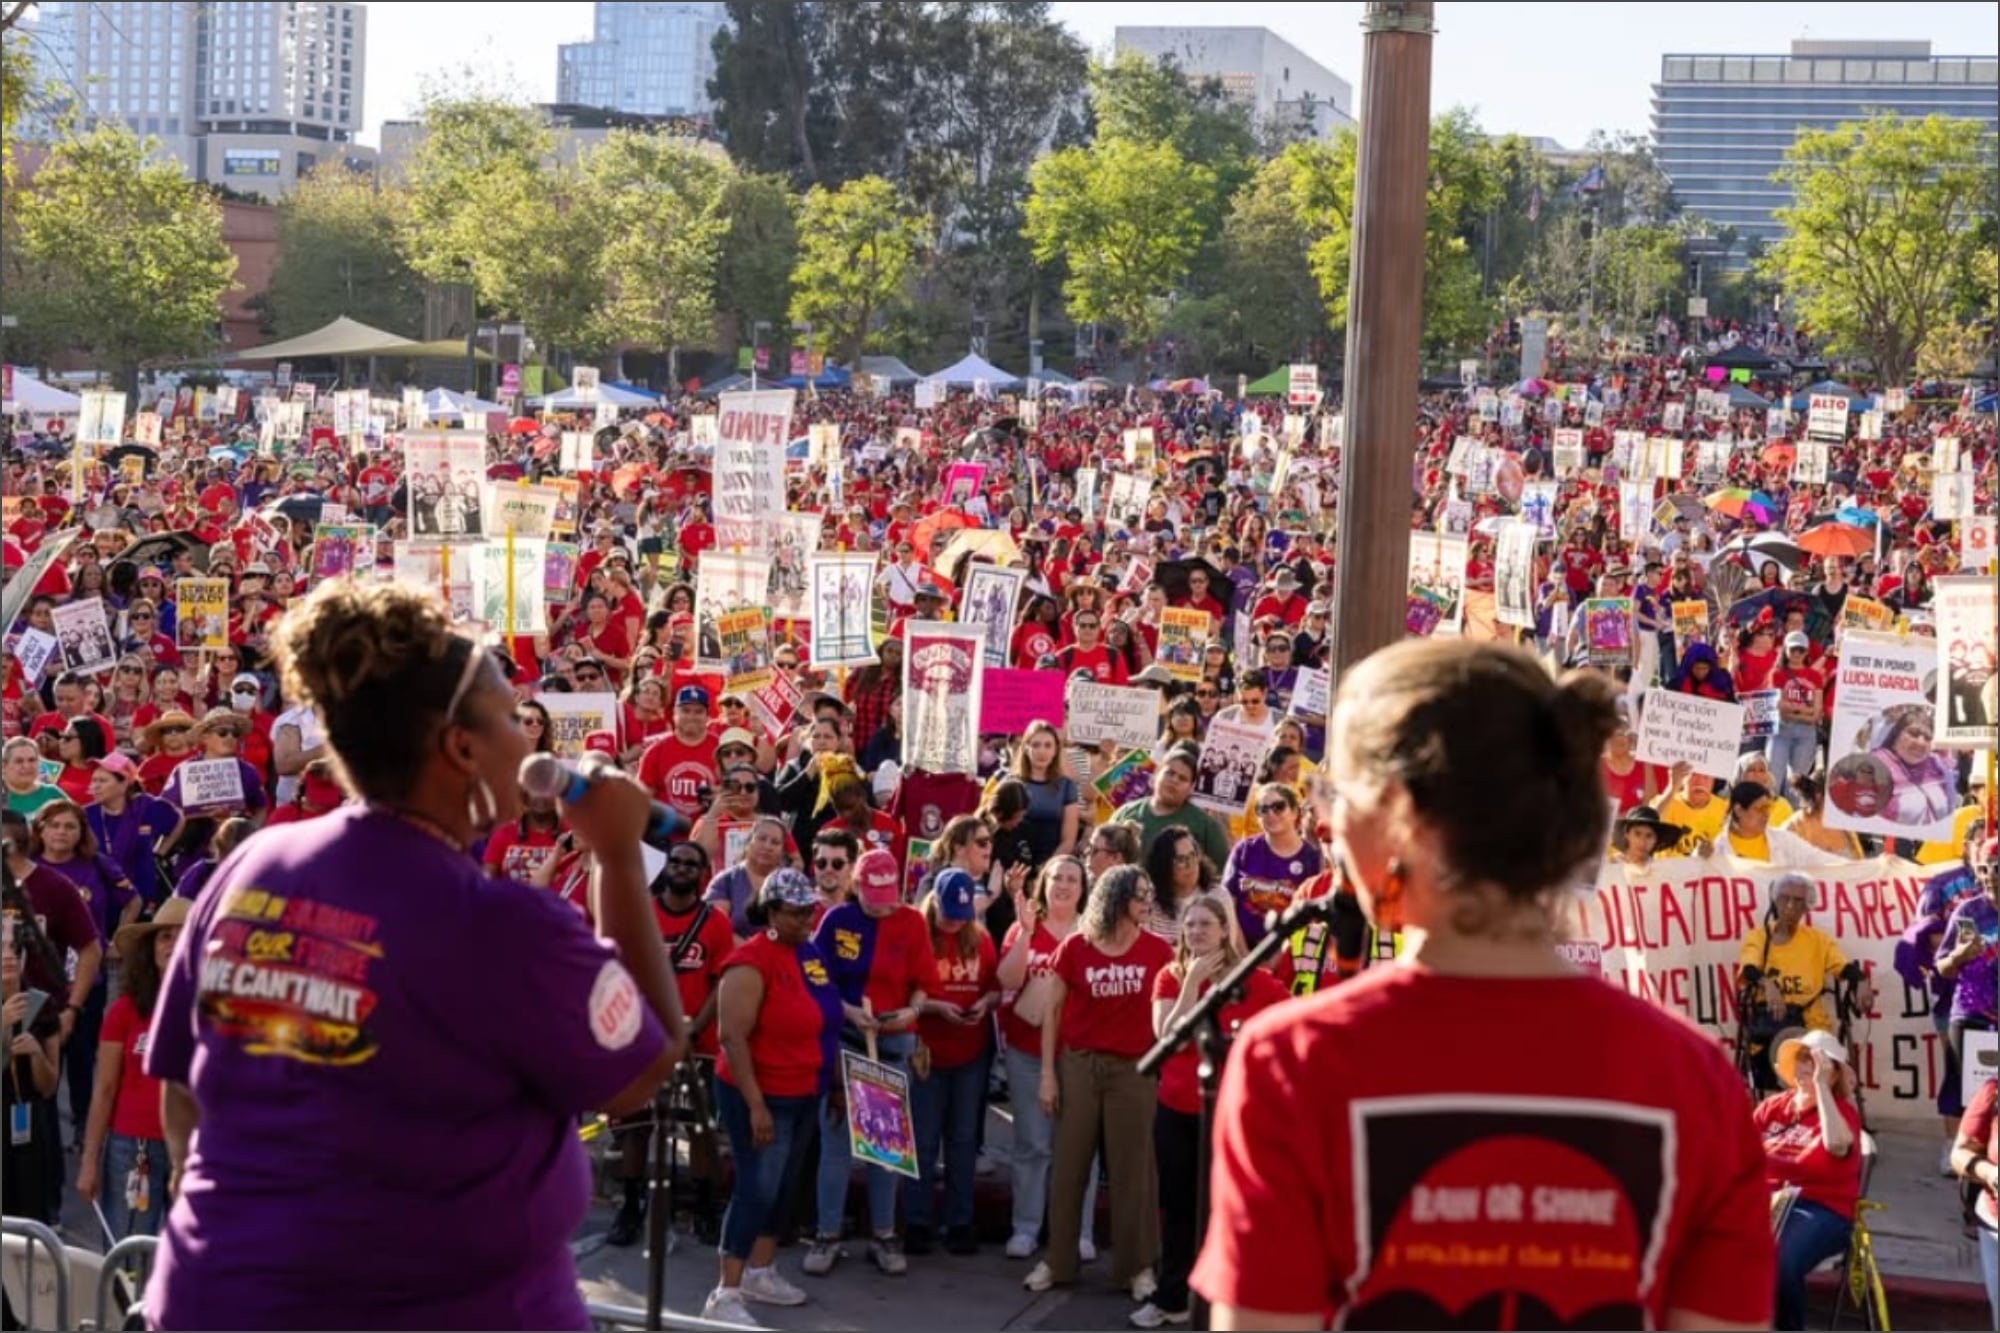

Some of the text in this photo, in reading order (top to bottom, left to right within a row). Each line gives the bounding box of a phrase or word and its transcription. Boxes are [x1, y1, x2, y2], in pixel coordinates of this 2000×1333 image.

[1812, 398, 1846, 410] ALTO
[504, 501, 547, 514] JUNTOS
[1850, 656, 1917, 672] REST IN POWER
[1843, 670, 1920, 692] LUCIA GARCIA
[551, 716, 603, 730] STRIKE
[1647, 710, 1662, 723] de
[1644, 727, 1671, 740] para
[1648, 740, 1708, 764] Especial
[1578, 876, 1933, 951] DUCATOR PAREN
[247, 930, 294, 960] OUR
[202, 957, 362, 1022] WE CAN'T WAIT
[1091, 979, 1142, 998] EQUITY
[1485, 1183, 1523, 1223] OR
[1531, 1186, 1618, 1228] SHINE
[1517, 1245, 1562, 1269] the
